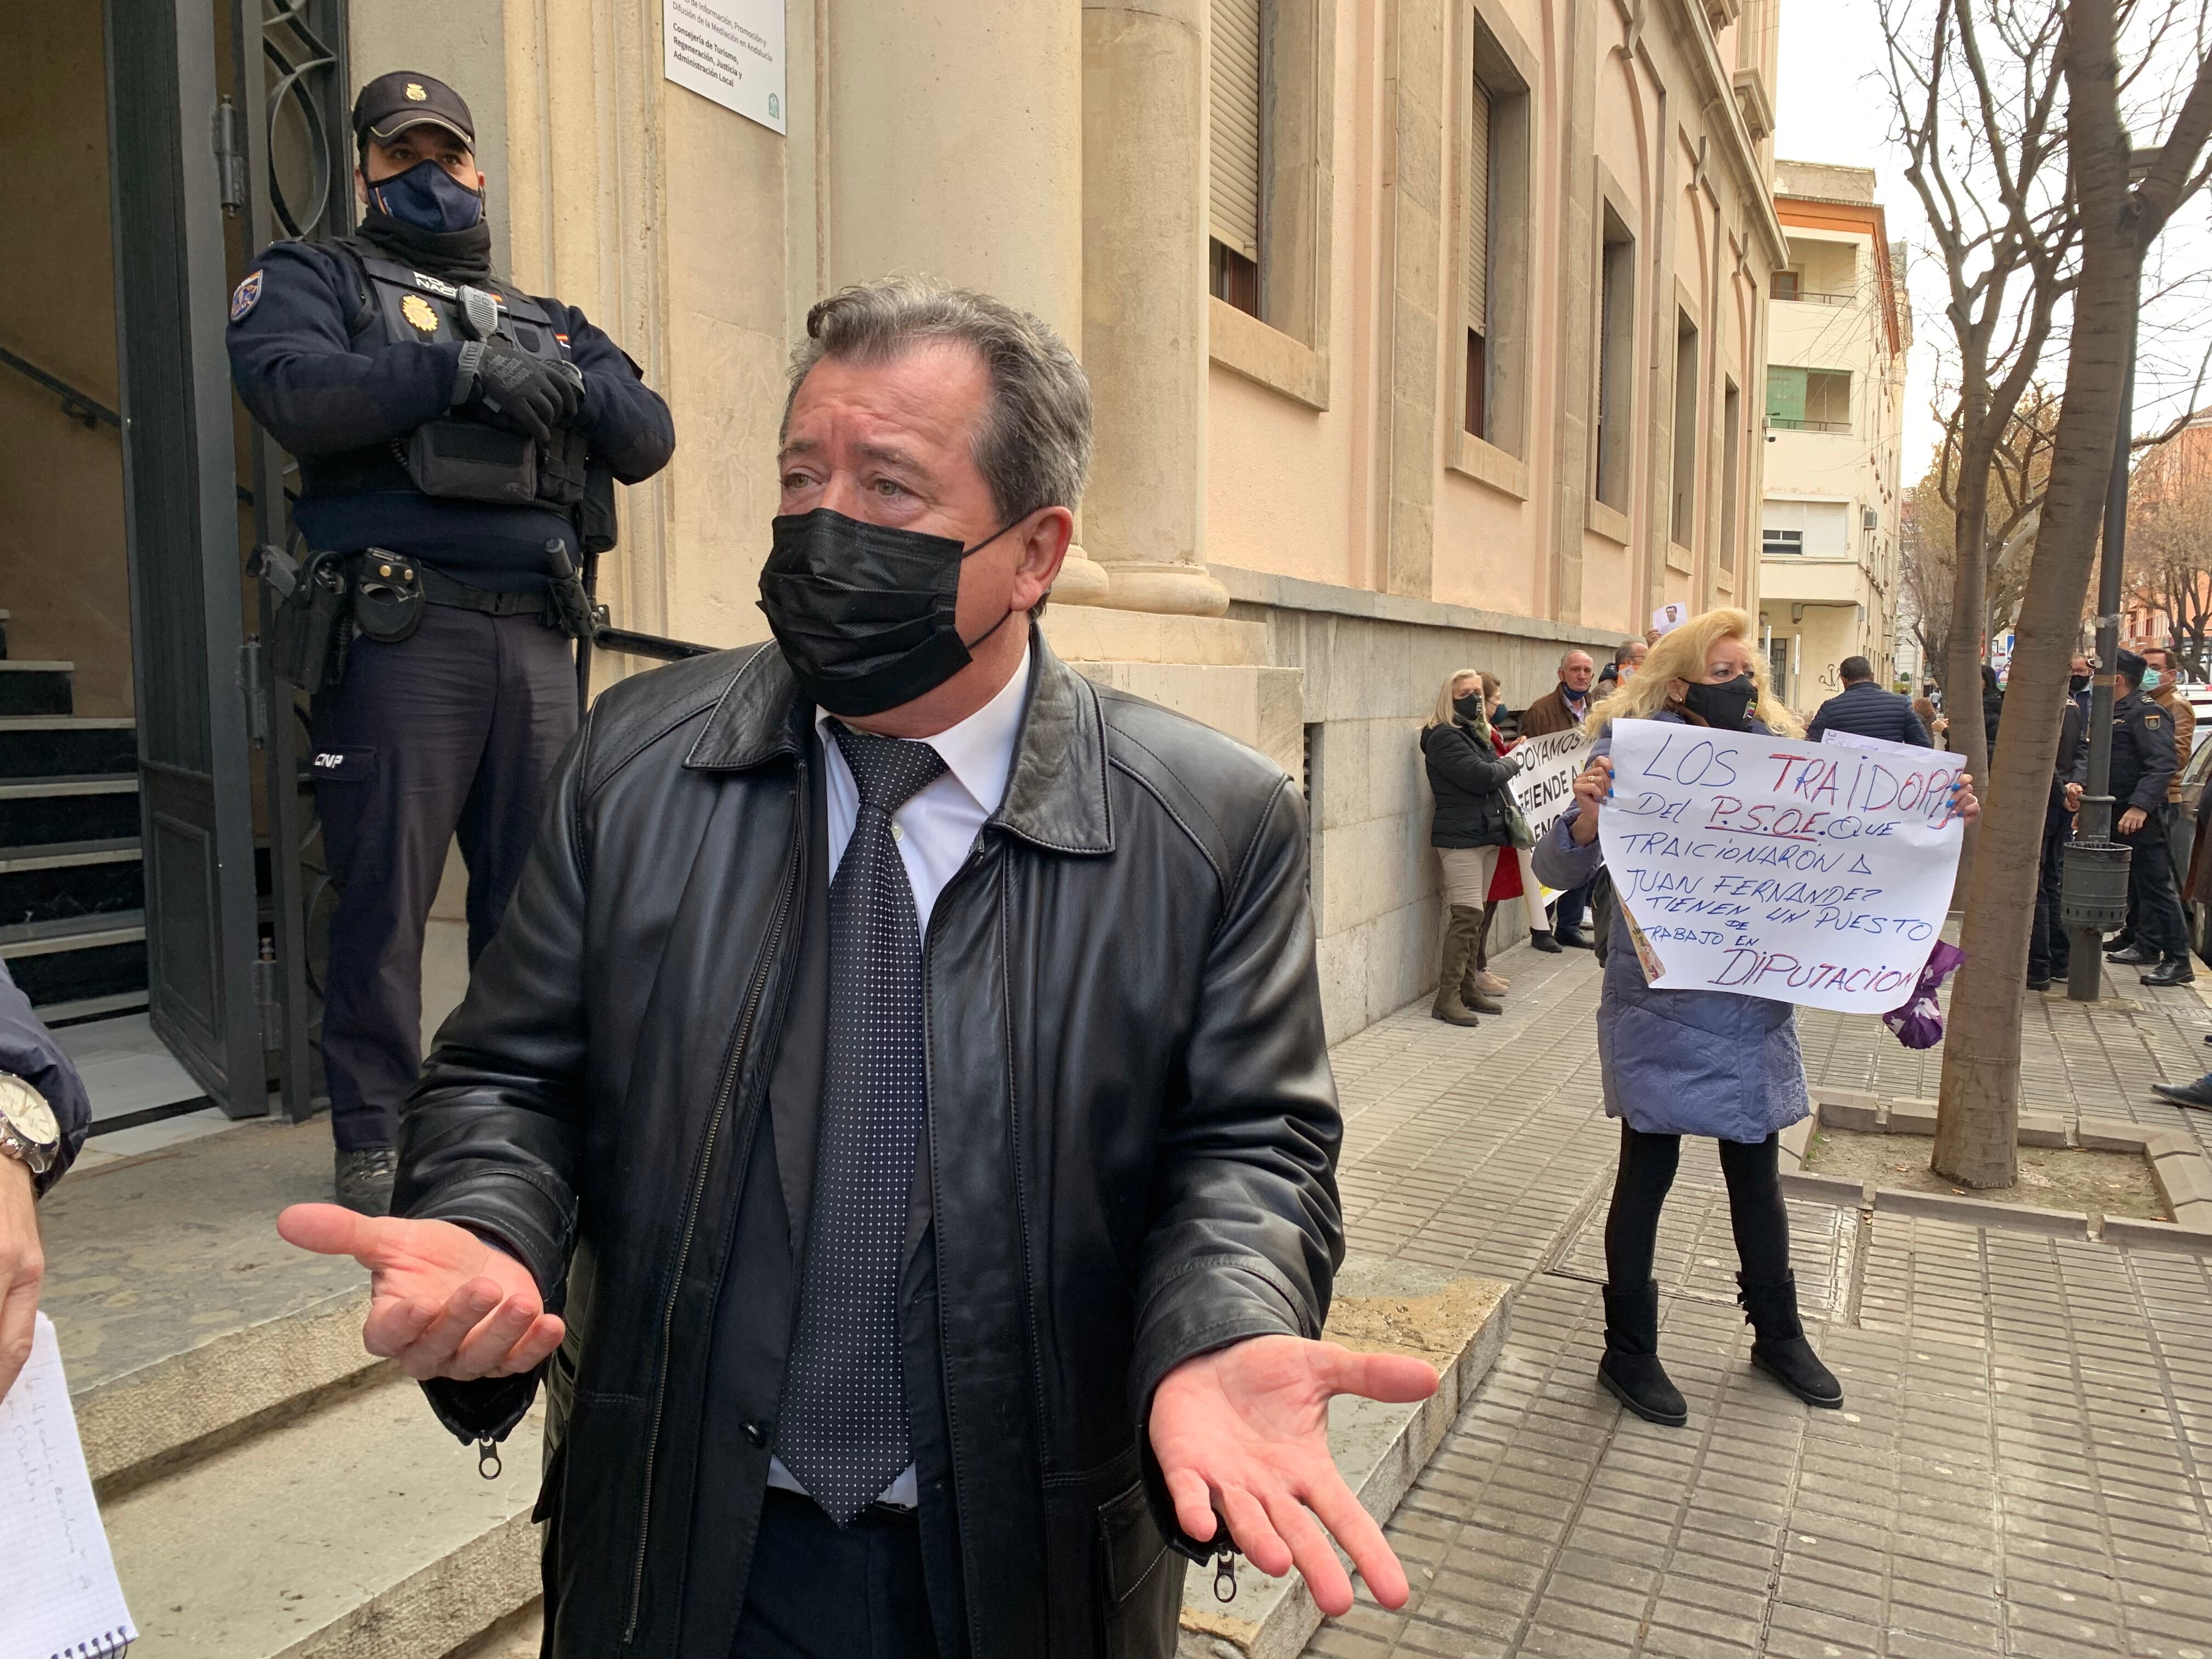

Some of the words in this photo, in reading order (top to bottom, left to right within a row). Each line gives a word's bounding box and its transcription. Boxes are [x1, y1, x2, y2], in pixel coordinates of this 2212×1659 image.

[673, 1, 696, 20] Difusión
[697, 15, 704, 25] de
[705, 18, 710, 29] la
[711, 22, 739, 44] Mediación
[740, 40, 747, 48] en
[747, 42, 772, 62] Andalucía
[673, 22, 704, 46] Consejería
[705, 40, 713, 50] de
[713, 43, 738, 65] Turismo,
[699, 2, 733, 29] Información,
[734, 21, 763, 44] Promoción
[763, 39, 767, 48] y
[673, 36, 715, 66] Regeneración,
[716, 59, 738, 76] Justicia
[738, 71, 742, 80] y
[673, 50, 718, 79] Administración
[719, 73, 735, 88] Local
[314, 753, 343, 769] CNP
[1642, 733, 1739, 787] LOS
[1827, 815, 1902, 839] QUE
[1847, 853, 1872, 874] A
[1624, 868, 1705, 902] JUAN
[1713, 876, 1883, 907] FERNANDEZ
[1646, 896, 1751, 916] TIENEN
[1766, 907, 1810, 924] UN
[1814, 906, 1933, 941] PUESTO
[1724, 920, 1750, 930] DE
[1735, 935, 1760, 946] EN
